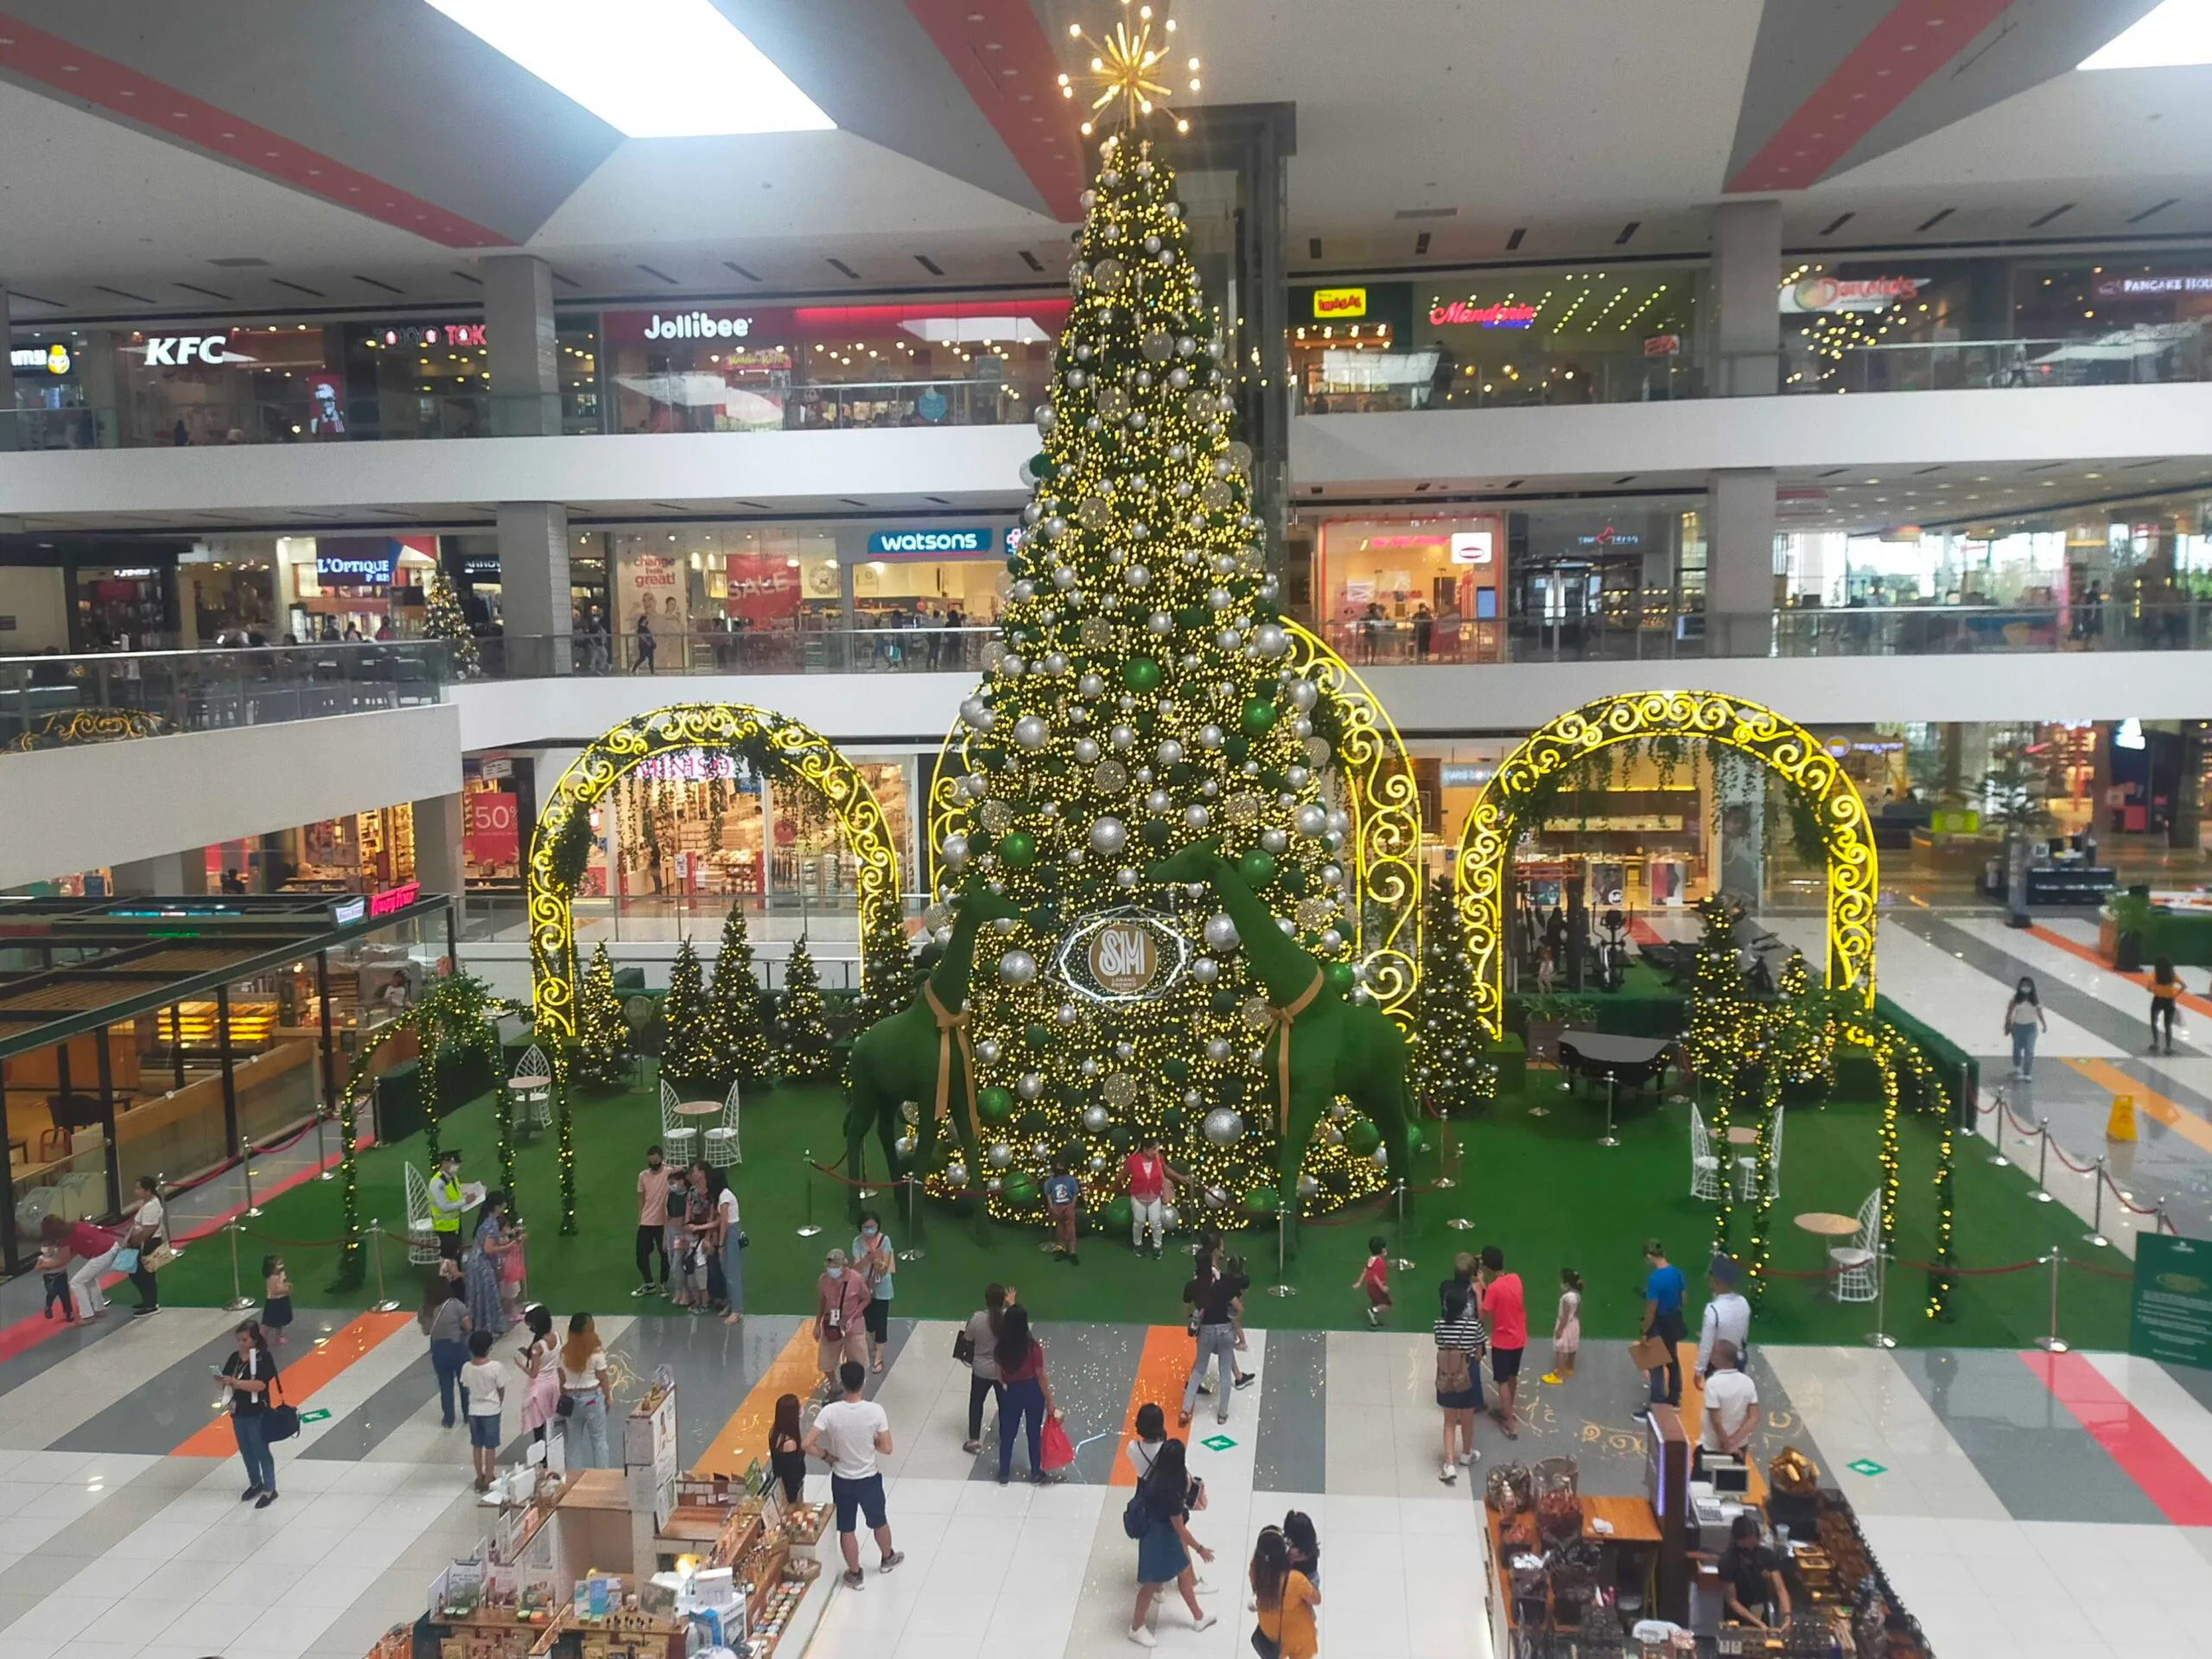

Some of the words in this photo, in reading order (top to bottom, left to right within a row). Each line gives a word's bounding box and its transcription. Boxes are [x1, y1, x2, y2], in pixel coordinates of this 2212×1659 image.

[2124, 279, 2183, 292] PANCAKE
[644, 311, 749, 340] Jollibee
[144, 335, 226, 365] KFC
[880, 533, 977, 551] watsons
[634, 556, 676, 568] change
[728, 570, 790, 601] SALE
[635, 754, 730, 779] MINISO
[1098, 930, 1146, 976] SM
